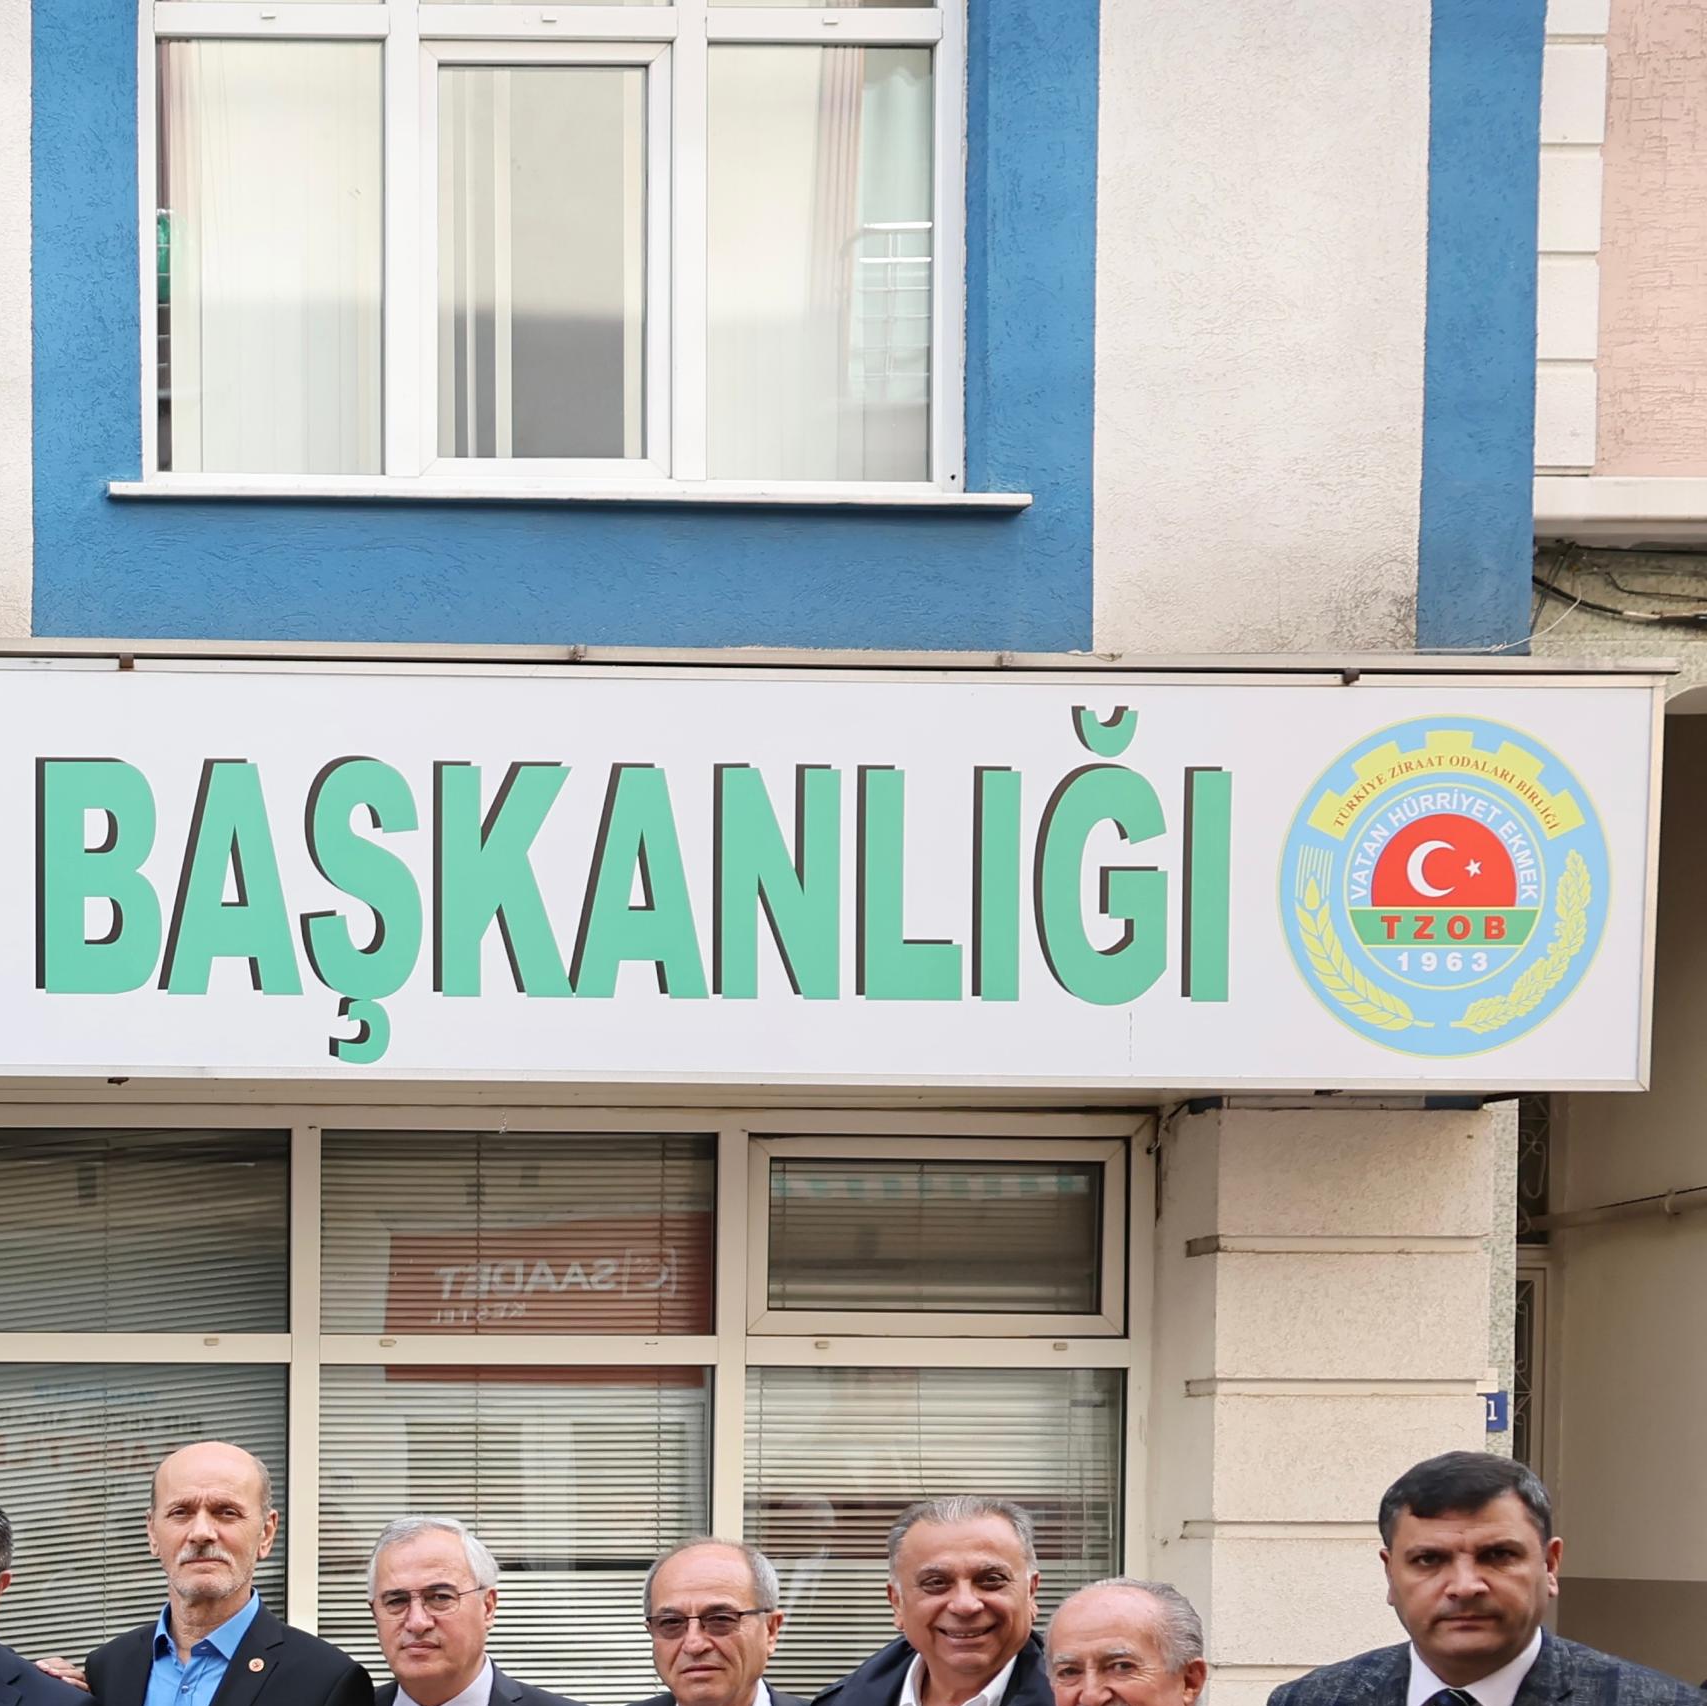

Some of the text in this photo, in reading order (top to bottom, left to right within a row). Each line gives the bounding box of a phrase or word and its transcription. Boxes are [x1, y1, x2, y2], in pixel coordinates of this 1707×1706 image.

[1333, 755, 1561, 831] TÜRKİYE ZİRAAT ODALARI BİRLİĞİ
[1349, 789, 1538, 901] VATAN HÜRRİYET EKMEK
[34, 705, 1232, 1066] BAŞKANLIĞI
[1380, 915, 1506, 940] TZOB
[1397, 952, 1488, 972] 1963
